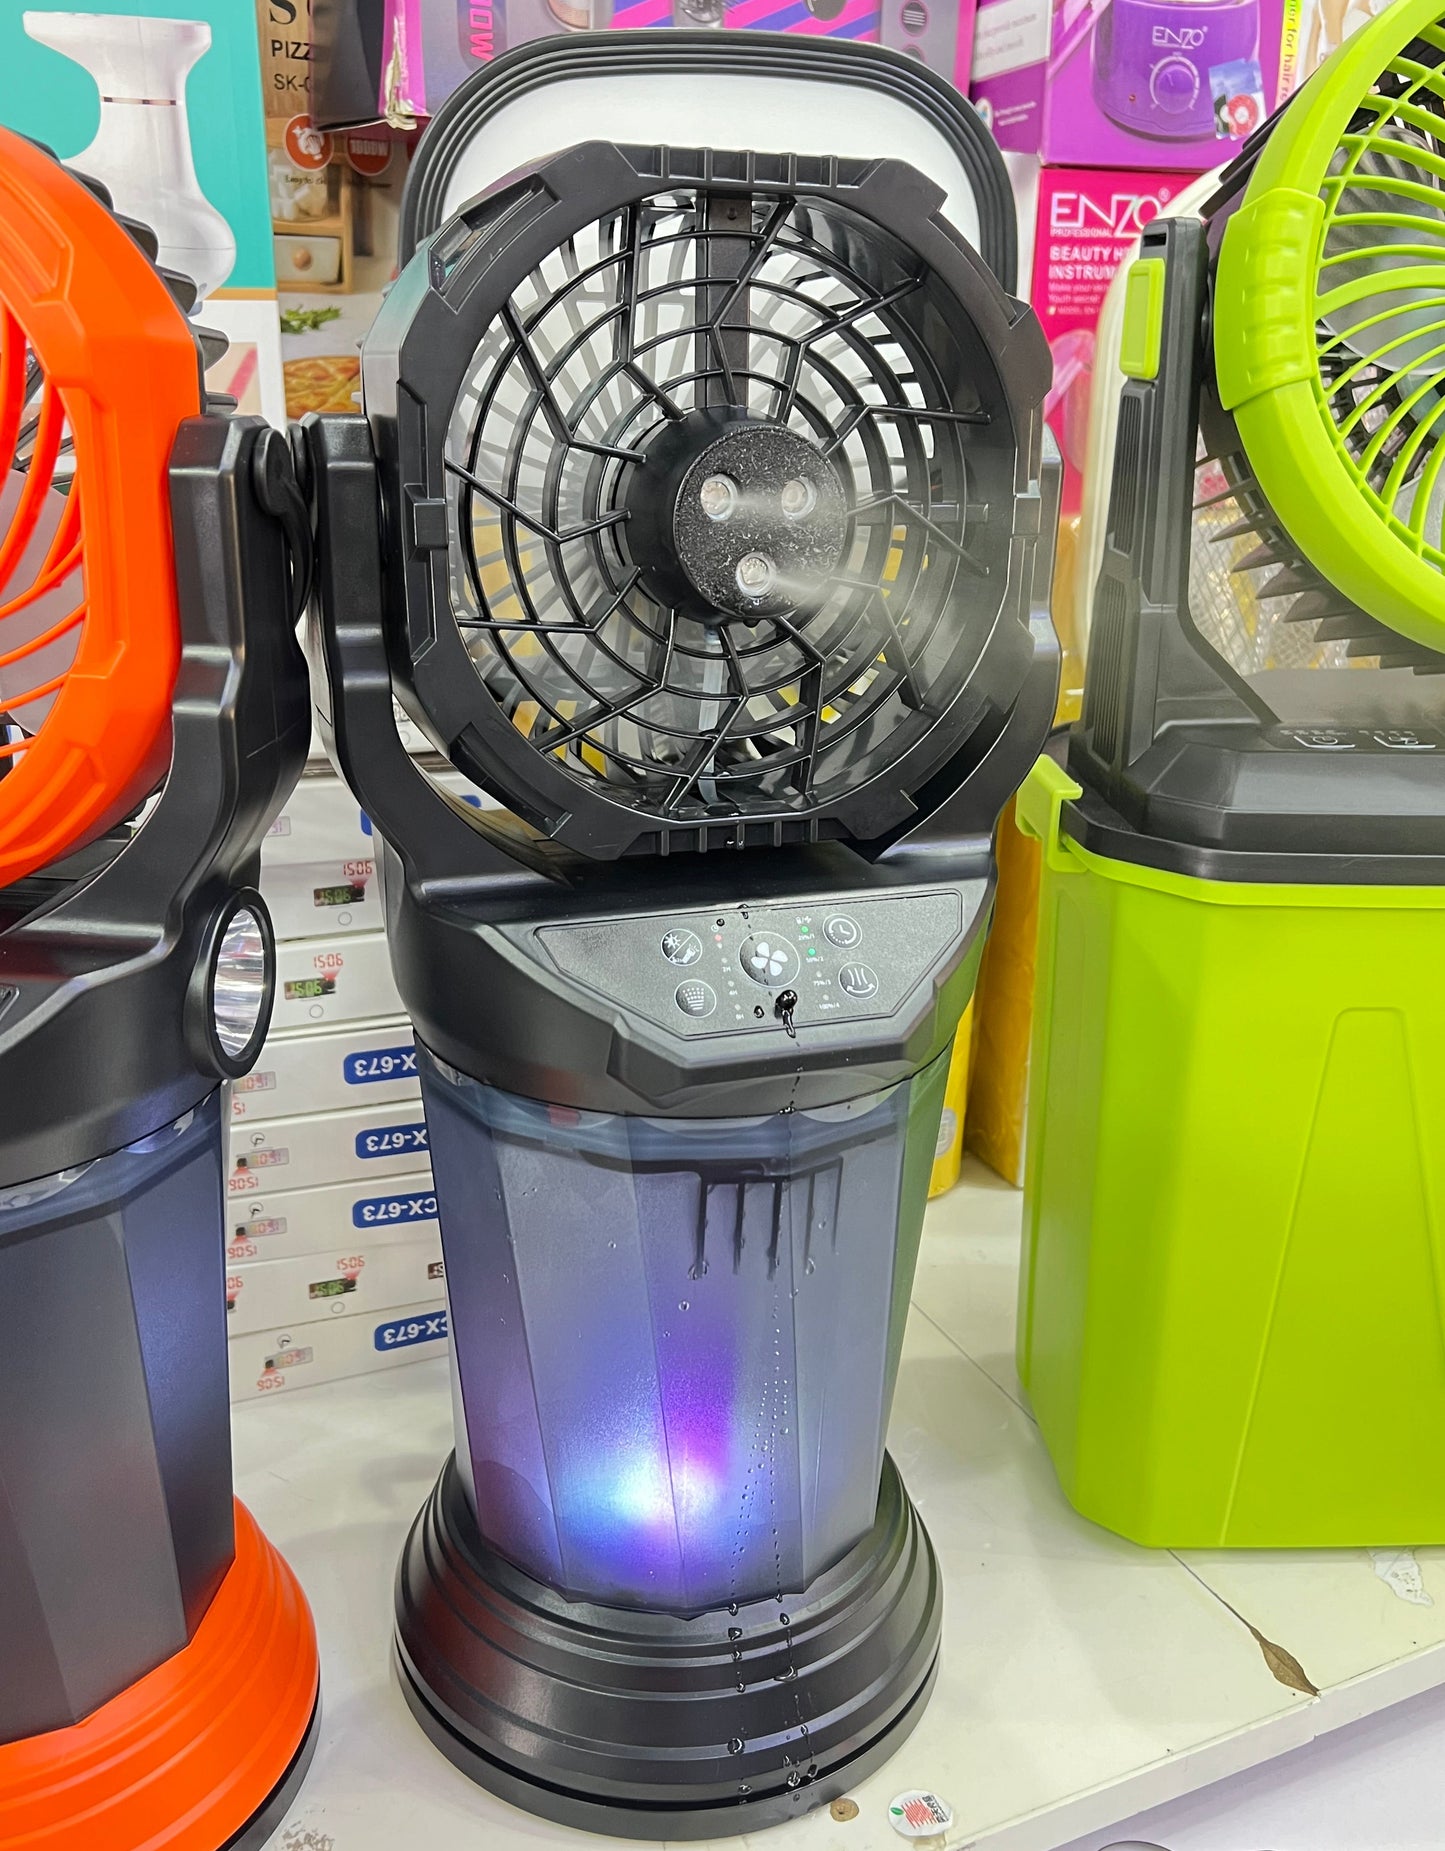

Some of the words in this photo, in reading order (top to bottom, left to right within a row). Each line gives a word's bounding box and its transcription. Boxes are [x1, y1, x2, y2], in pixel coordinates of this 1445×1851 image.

[269, 0, 311, 25] S
[1152, 26, 1204, 49] ENZO
[1286, 28, 1297, 49] for
[1282, 53, 1296, 82] hair
[274, 74, 312, 93] SK-
[1050, 192, 1163, 238] ENZO
[1049, 245, 1112, 262] BEAUTY
[354, 1052, 417, 1075] X-673
[366, 1128, 428, 1153] X-673
[362, 1197, 438, 1222] CX-673
